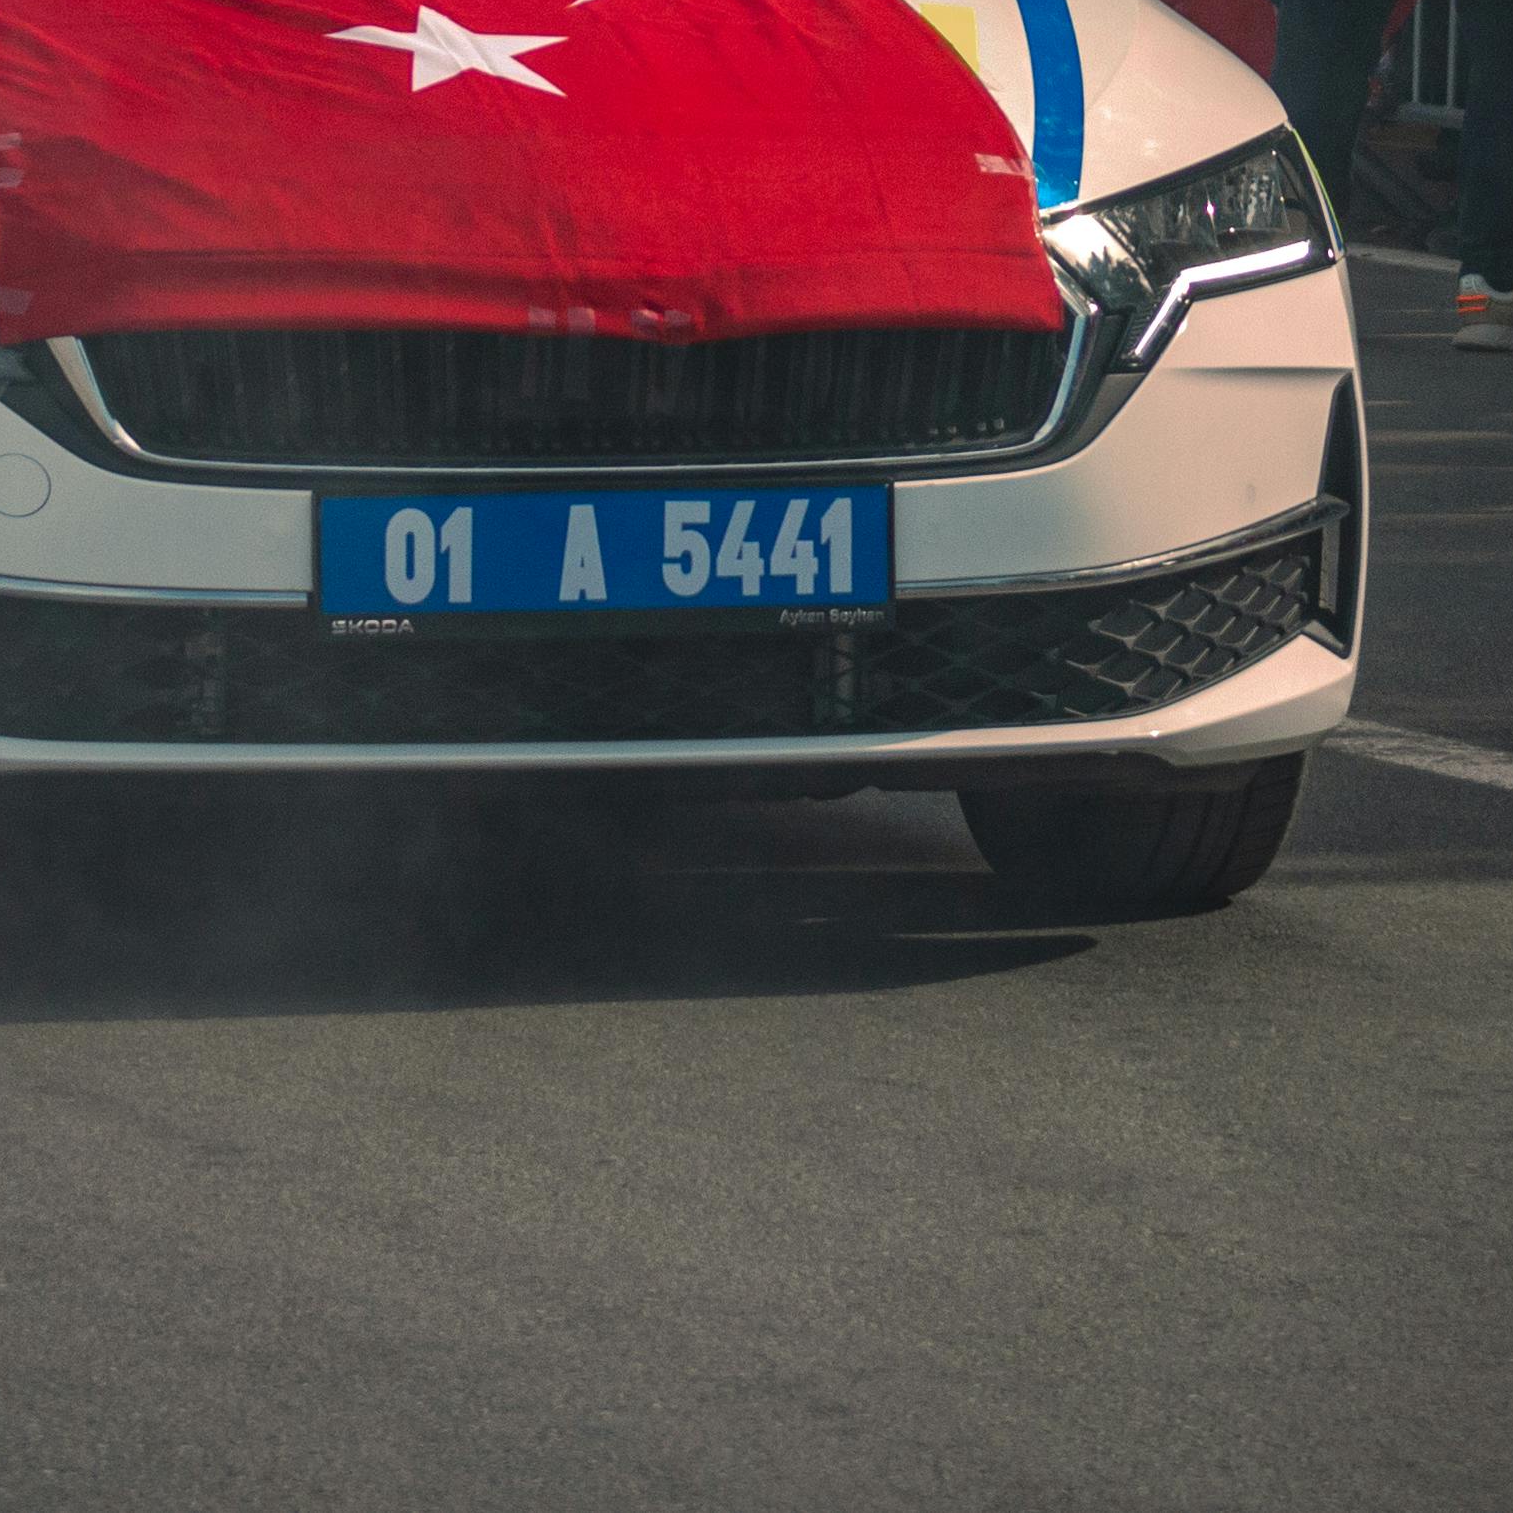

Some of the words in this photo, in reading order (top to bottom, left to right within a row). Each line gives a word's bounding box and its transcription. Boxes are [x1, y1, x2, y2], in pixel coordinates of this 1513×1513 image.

[384, 506, 473, 605] 01
[558, 503, 608, 601] A
[661, 497, 854, 598] 5441
